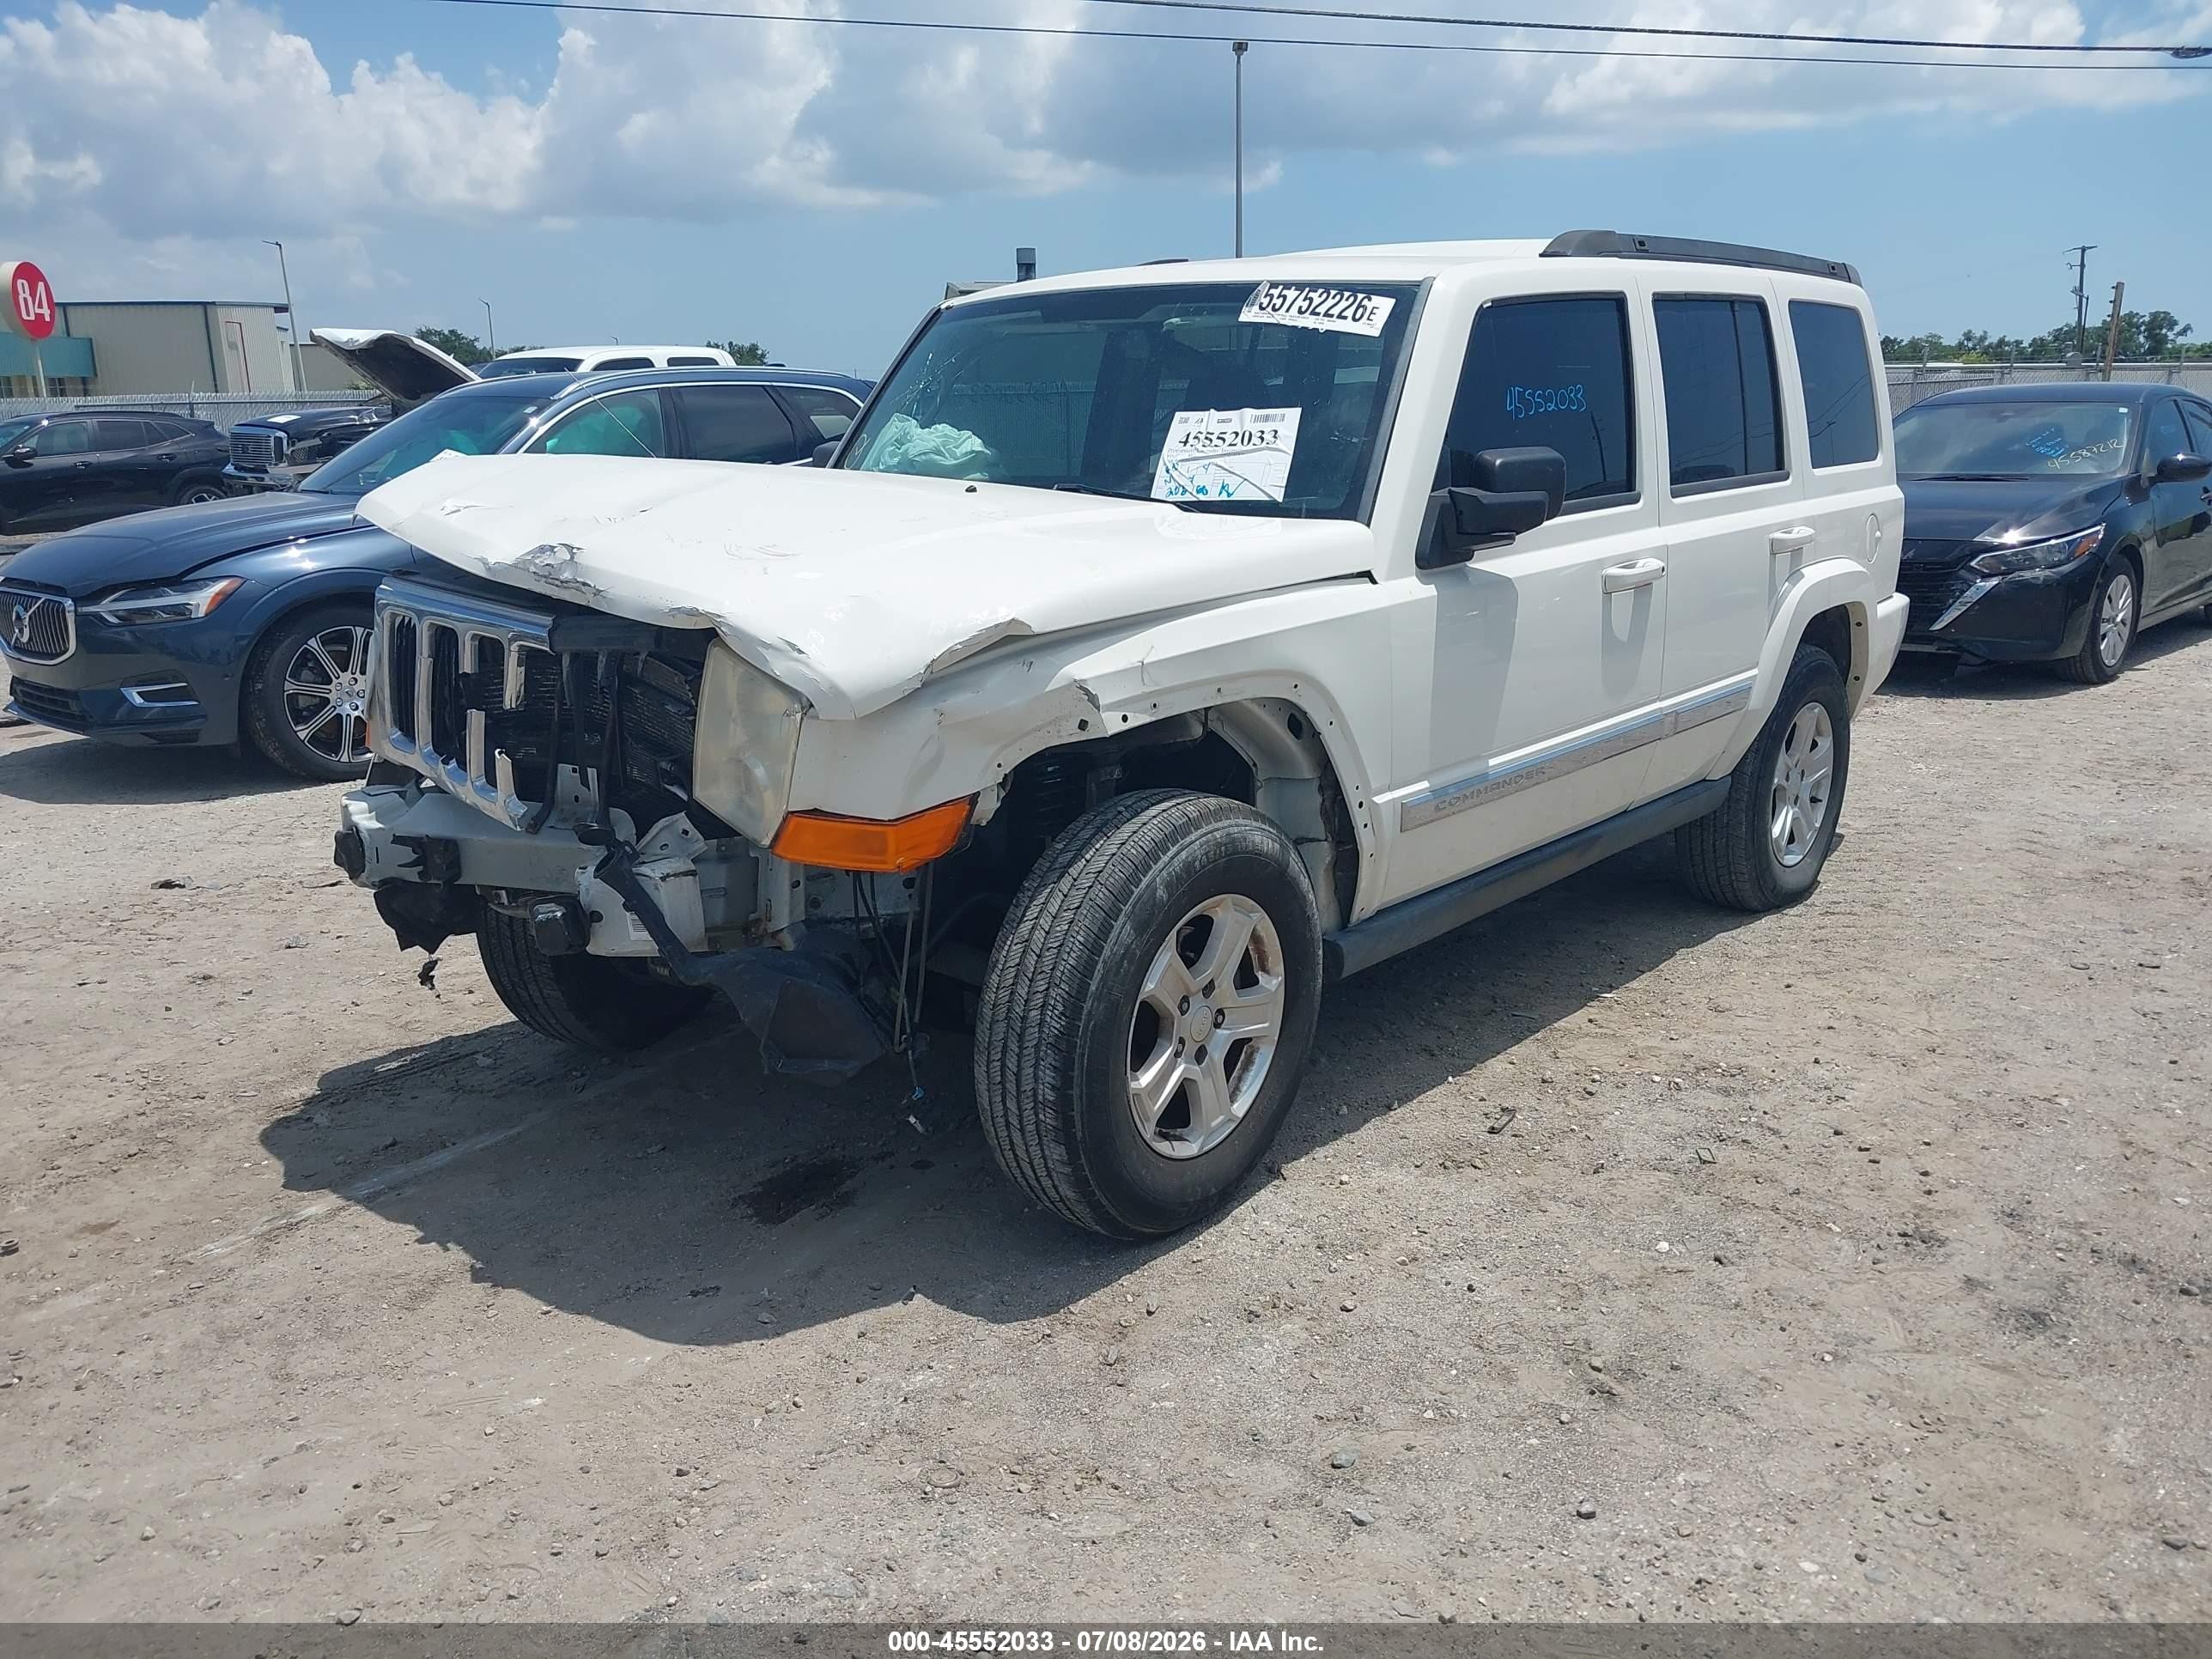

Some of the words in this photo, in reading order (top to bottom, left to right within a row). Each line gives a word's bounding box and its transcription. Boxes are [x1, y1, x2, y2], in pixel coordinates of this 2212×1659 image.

[16, 279, 51, 322] 84
[1506, 385, 1587, 420] 45552033
[1178, 428, 1279, 448] 45552033
[1435, 767, 1547, 811] COMMANDER
